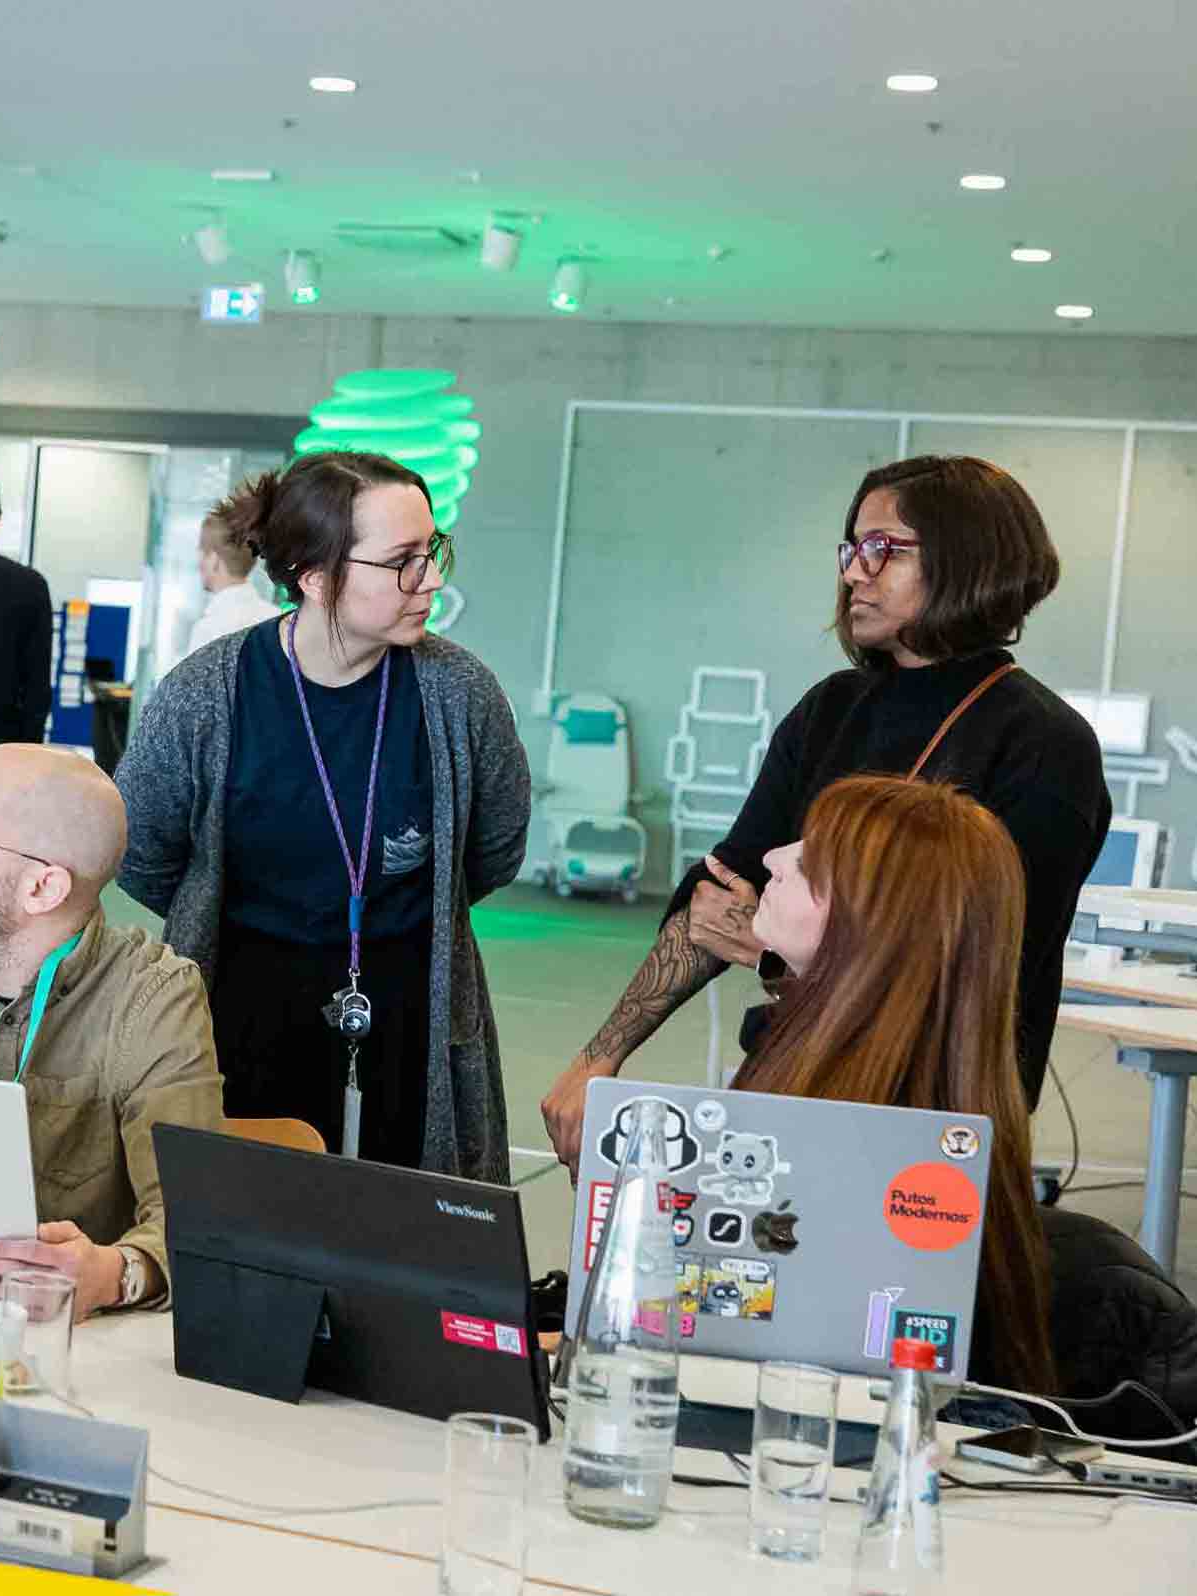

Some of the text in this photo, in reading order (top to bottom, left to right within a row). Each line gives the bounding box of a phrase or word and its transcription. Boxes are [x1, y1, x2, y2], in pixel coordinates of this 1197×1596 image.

[890, 1189, 936, 1206] Putos
[436, 1199, 498, 1224] ViewSonic
[905, 1316, 949, 1330] #SPEED
